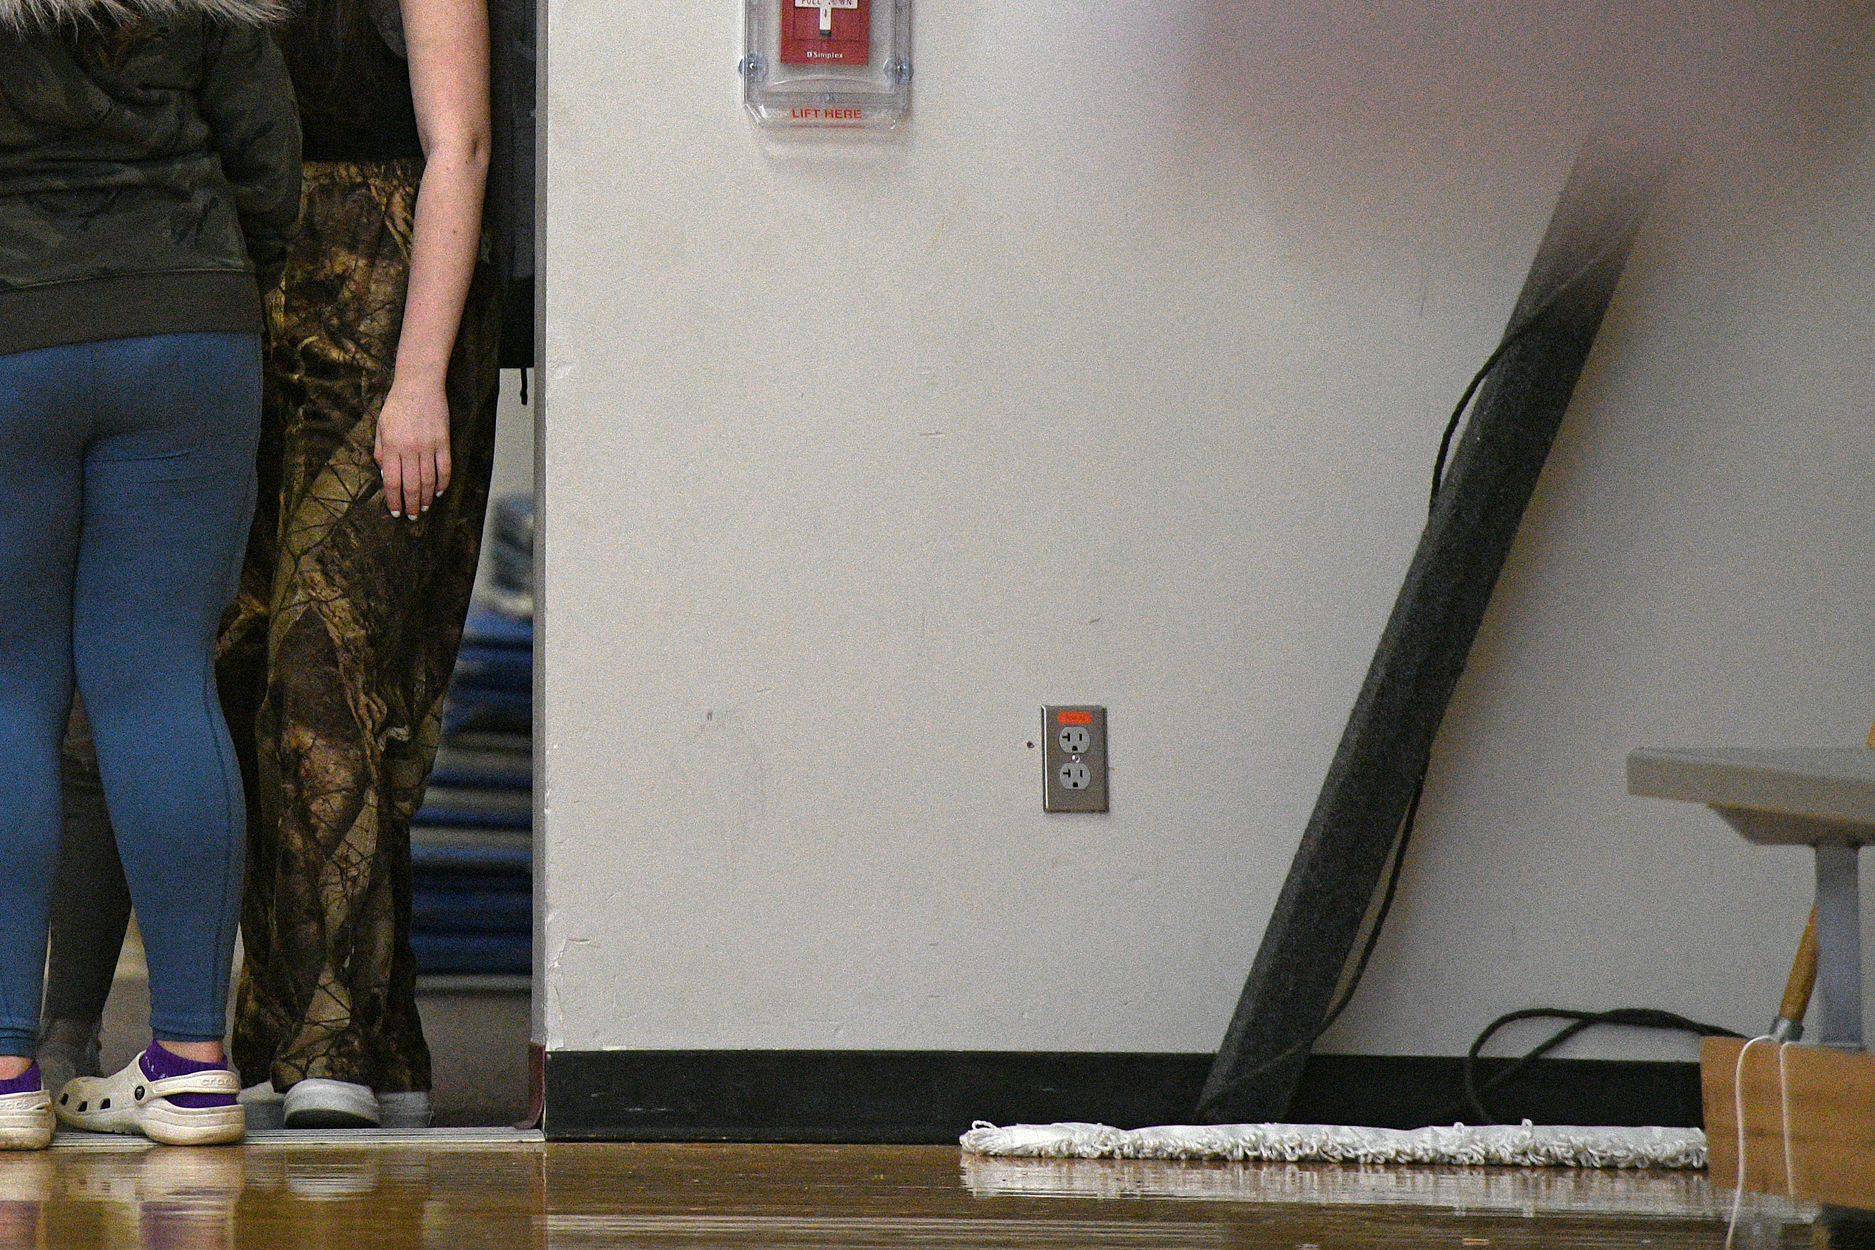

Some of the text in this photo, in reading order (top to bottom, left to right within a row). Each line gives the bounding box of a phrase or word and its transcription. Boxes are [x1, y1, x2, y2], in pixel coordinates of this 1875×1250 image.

[813, 51, 843, 60] Simplex
[792, 108, 862, 119] LIFT HERE
